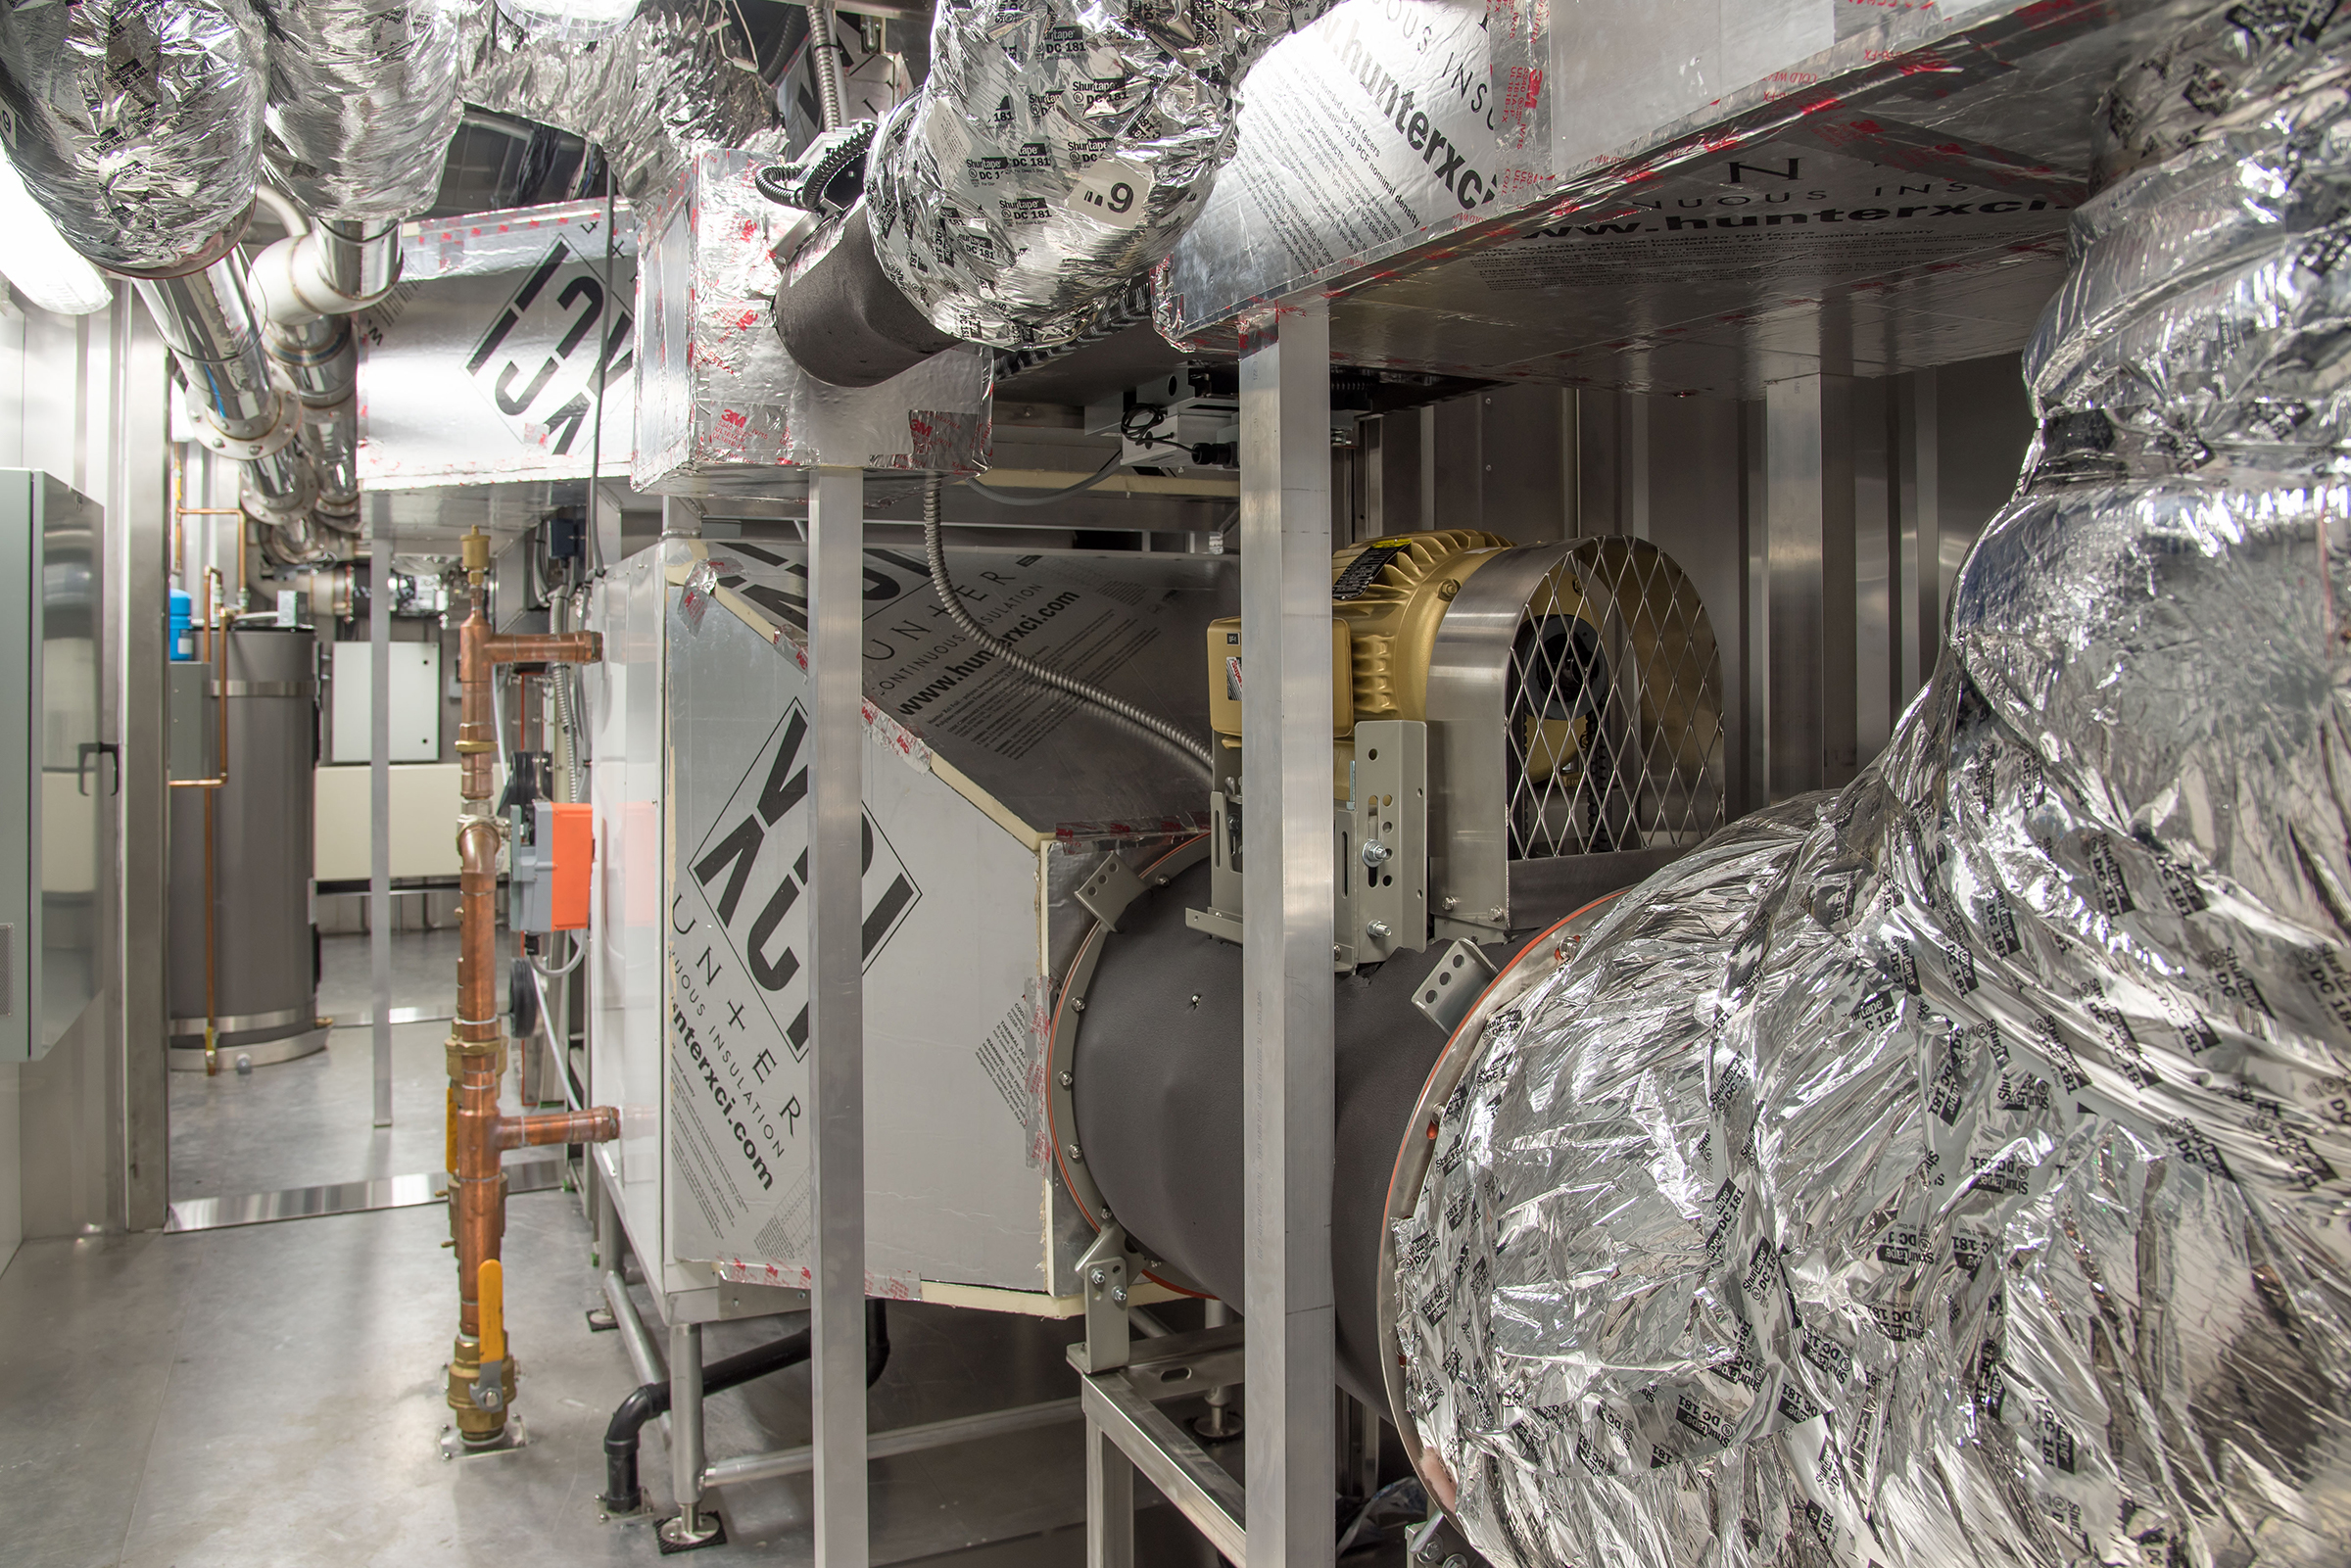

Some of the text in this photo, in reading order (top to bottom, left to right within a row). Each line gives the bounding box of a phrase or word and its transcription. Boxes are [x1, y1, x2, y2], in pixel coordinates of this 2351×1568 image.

[1047, 41, 1086, 53] DC 181
[1073, 81, 1117, 92] Shurtape
[1502, 67, 1517, 122] UL181B-FX
[993, 112, 1015, 122] 181
[1068, 139, 1108, 152] Shurtape
[967, 158, 1002, 169] Shurtape
[1013, 157, 1051, 166] DC 181
[980, 171, 994, 180] DC
[999, 200, 1040, 211] Shurtape
[1014, 210, 1052, 220] DC 181
[736, 309, 759, 332] 3M
[721, 409, 747, 428] 3M
[910, 419, 934, 438] 3M
[2093, 858, 2121, 921] DC 181
[2170, 886, 2193, 920] 181
[1987, 905, 2008, 960] DC 181
[1890, 953, 1901, 974] DC
[1952, 969, 1969, 999] 181
[2217, 973, 2237, 997] DC
[2310, 970, 2335, 994] DC
[1851, 999, 1884, 1021] urtape
[2087, 1003, 2106, 1024] DC
[2179, 1025, 2203, 1057] 181
[1709, 1063, 1739, 1104] Shurtape
[2058, 1064, 2078, 1095] 181
[2122, 1064, 2145, 1092] 181
[670, 1001, 774, 1192] nterxci.com
[708, 1025, 786, 1159] INSULATION
[1725, 1083, 1738, 1101] DC
[1928, 1065, 1952, 1115] DC 181
[2177, 1139, 2197, 1164] DC
[1718, 1189, 1746, 1231] DC 181
[1899, 1233, 1917, 1246] DC
[1951, 1236, 1976, 1251] 181
[1743, 1249, 1767, 1293] Shurtape
[1758, 1272, 1771, 1291] DC
[1421, 1289, 1444, 1315] DC 181
[1893, 1310, 1911, 1322] DC
[1735, 1354, 1752, 1371] DC
[1821, 1344, 1842, 1360] DC
[1678, 1394, 1701, 1415] 181
[1783, 1382, 1819, 1417] DC 181
[1607, 1413, 1622, 1429] DC
[1703, 1410, 1721, 1427] DC
[1684, 1413, 1731, 1449] Shurtape
[2042, 1409, 2056, 1466] DC 181
[1578, 1433, 1606, 1467] DC 181
[1653, 1444, 1673, 1464] 181
[1820, 1511, 1834, 1535] 181
